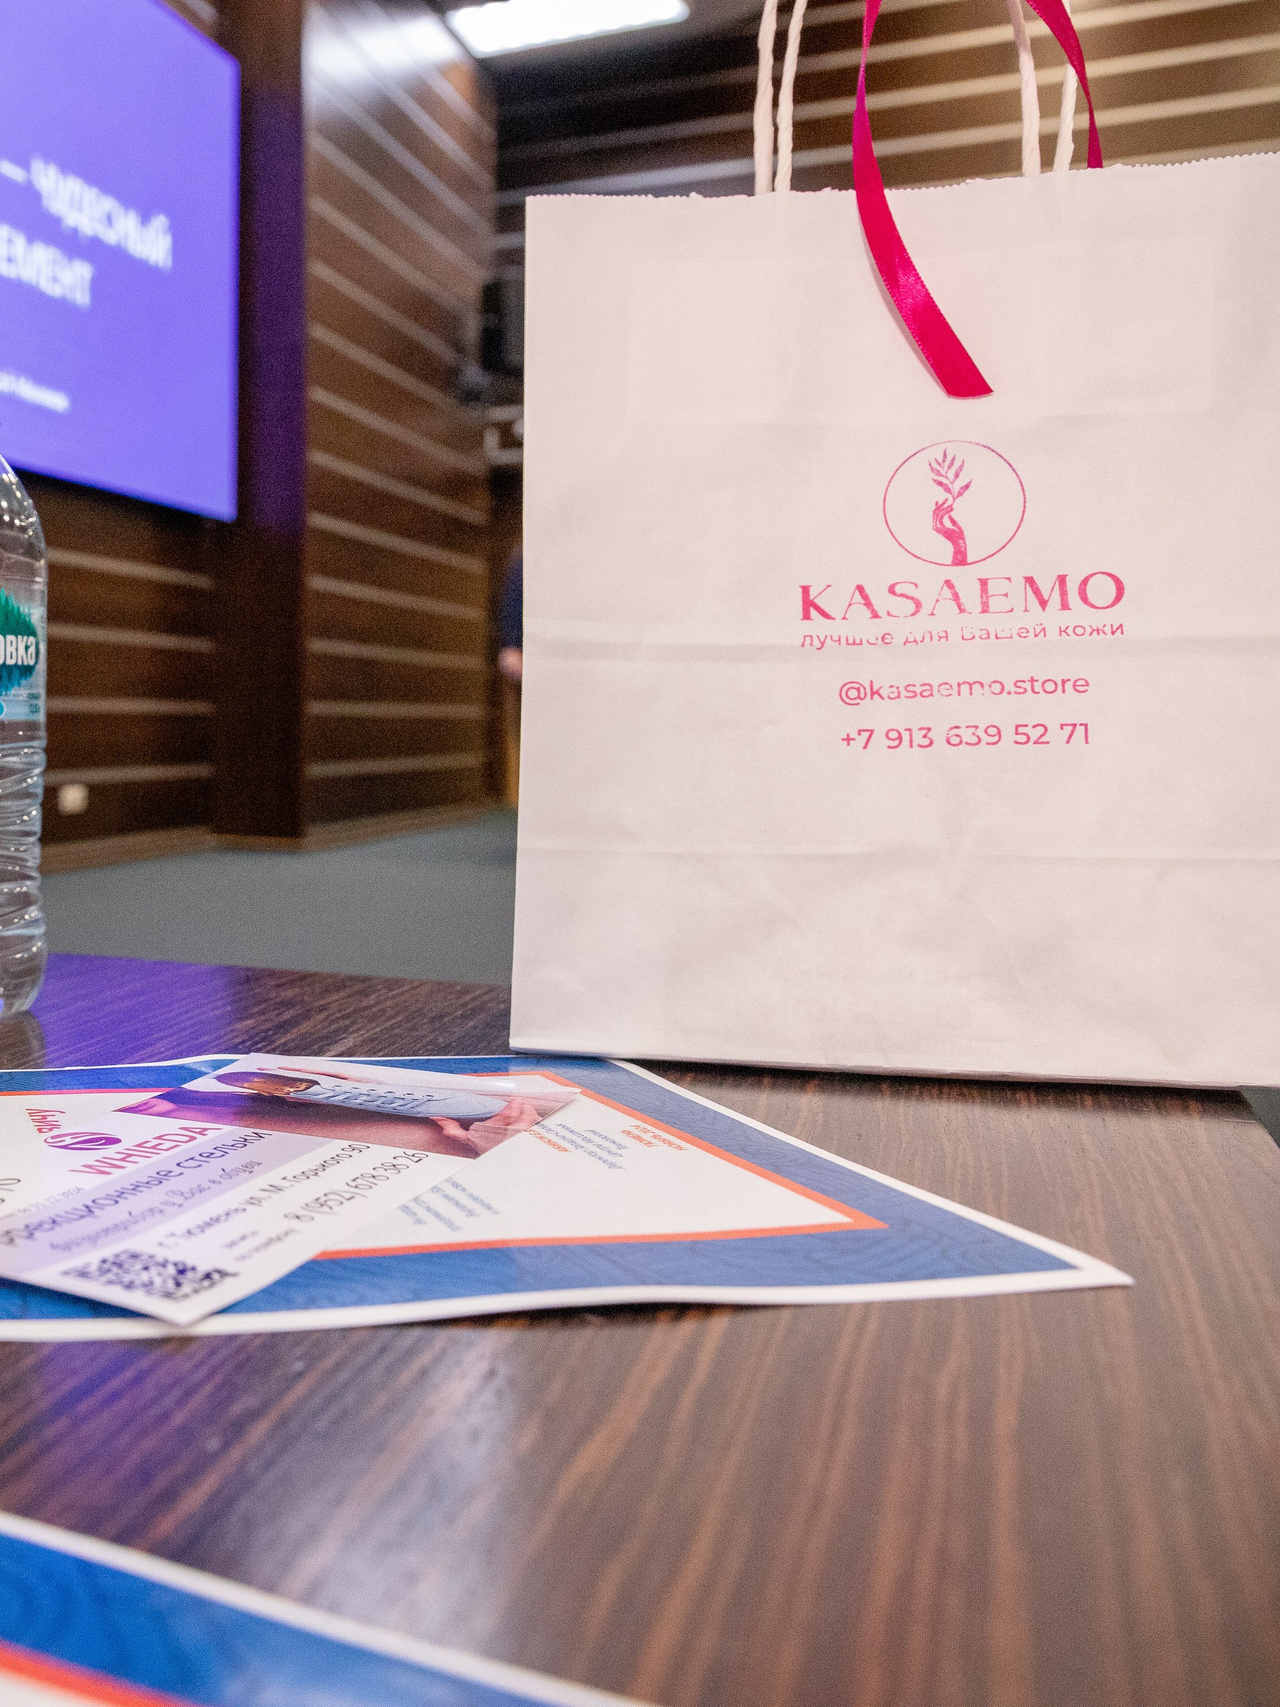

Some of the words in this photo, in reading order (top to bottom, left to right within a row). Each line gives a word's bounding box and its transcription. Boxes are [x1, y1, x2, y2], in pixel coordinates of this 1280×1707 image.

[29, 155, 174, 270] ЧУДЕСНЫЙ
[798, 571, 1126, 621] KASAEMO
[800, 629, 894, 650] лучше
[903, 629, 950, 646] для
[1057, 622, 1125, 638] кожи
[838, 675, 1090, 706] @kasaemo.store
[841, 728, 875, 750] +7
[885, 726, 934, 750] 913
[944, 724, 1003, 748] 639
[1013, 723, 1050, 746] 52
[1059, 722, 1090, 745] 71
[25, 1107, 66, 1134] вичу
[67, 1126, 224, 1177] WHIEDA
[176, 1131, 273, 1169] стельки
[166, 1206, 247, 1240] Тюмень
[281, 1152, 353, 1183] Горького
[348, 1142, 371, 1154] 90
[283, 1211, 316, 1223] 8
[301, 1189, 368, 1216] (952)
[346, 1173, 389, 1191] 678
[373, 1161, 409, 1176] 38
[393, 1150, 429, 1164] 26
